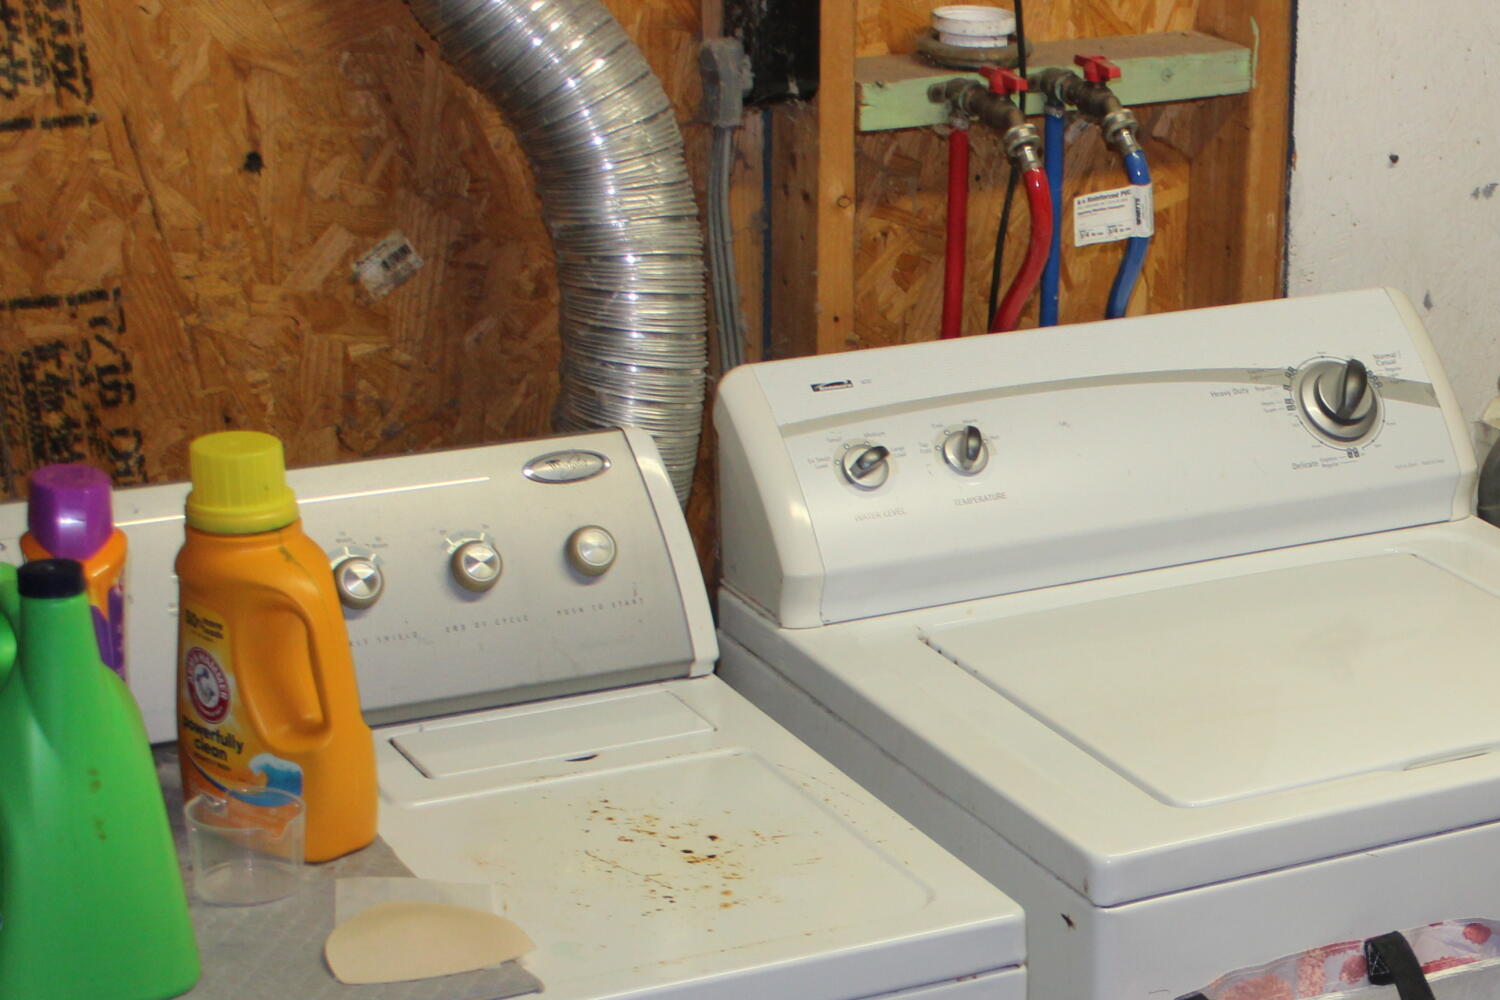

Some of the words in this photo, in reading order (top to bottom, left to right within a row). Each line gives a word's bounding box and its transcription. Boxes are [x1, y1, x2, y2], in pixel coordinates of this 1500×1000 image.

[954, 491, 1007, 507] TEMPERATURE
[183, 715, 245, 755] powerfully
[194, 737, 228, 761] clean
